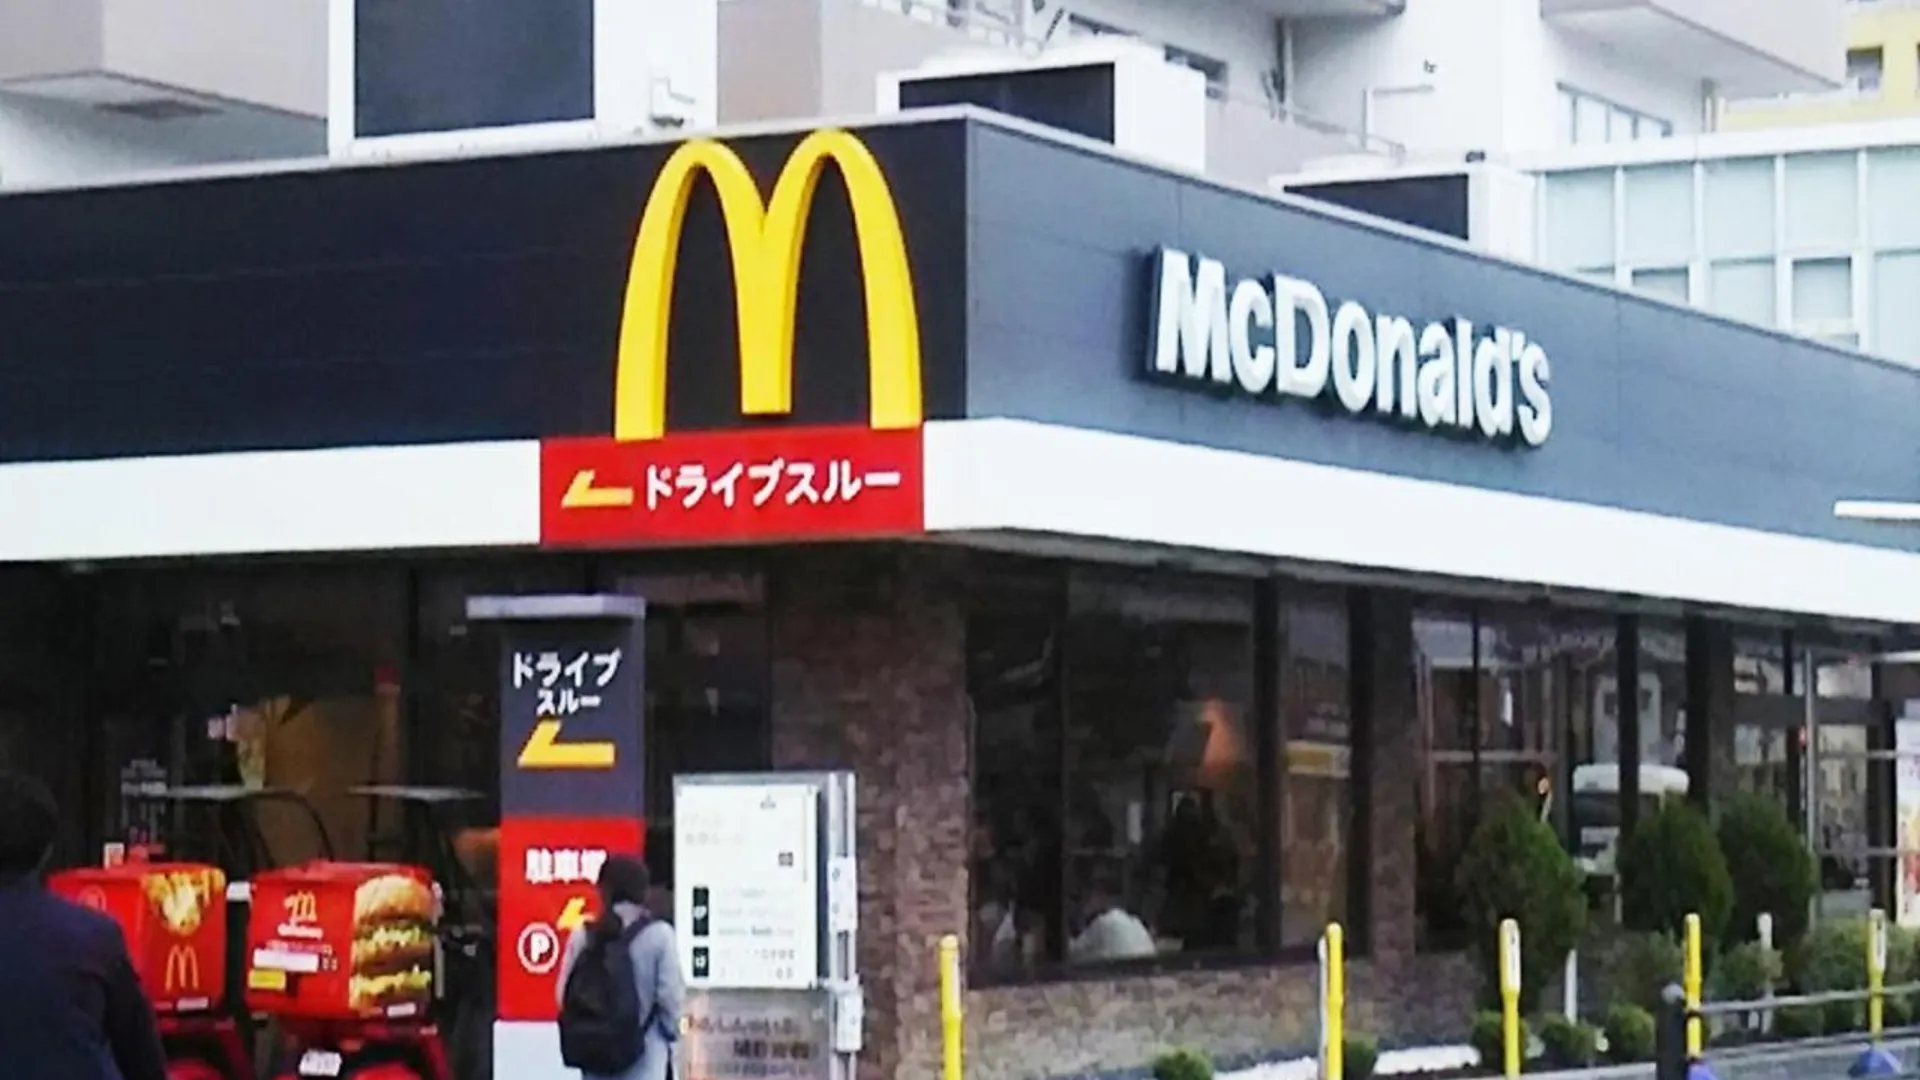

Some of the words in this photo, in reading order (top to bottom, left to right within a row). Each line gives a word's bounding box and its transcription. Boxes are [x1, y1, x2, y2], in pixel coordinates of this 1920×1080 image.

[1155, 246, 1551, 446] McDonald's
[646, 457, 902, 510] ドライブスルー
[513, 647, 621, 688] ドライブ
[536, 688, 601, 716] スルー
